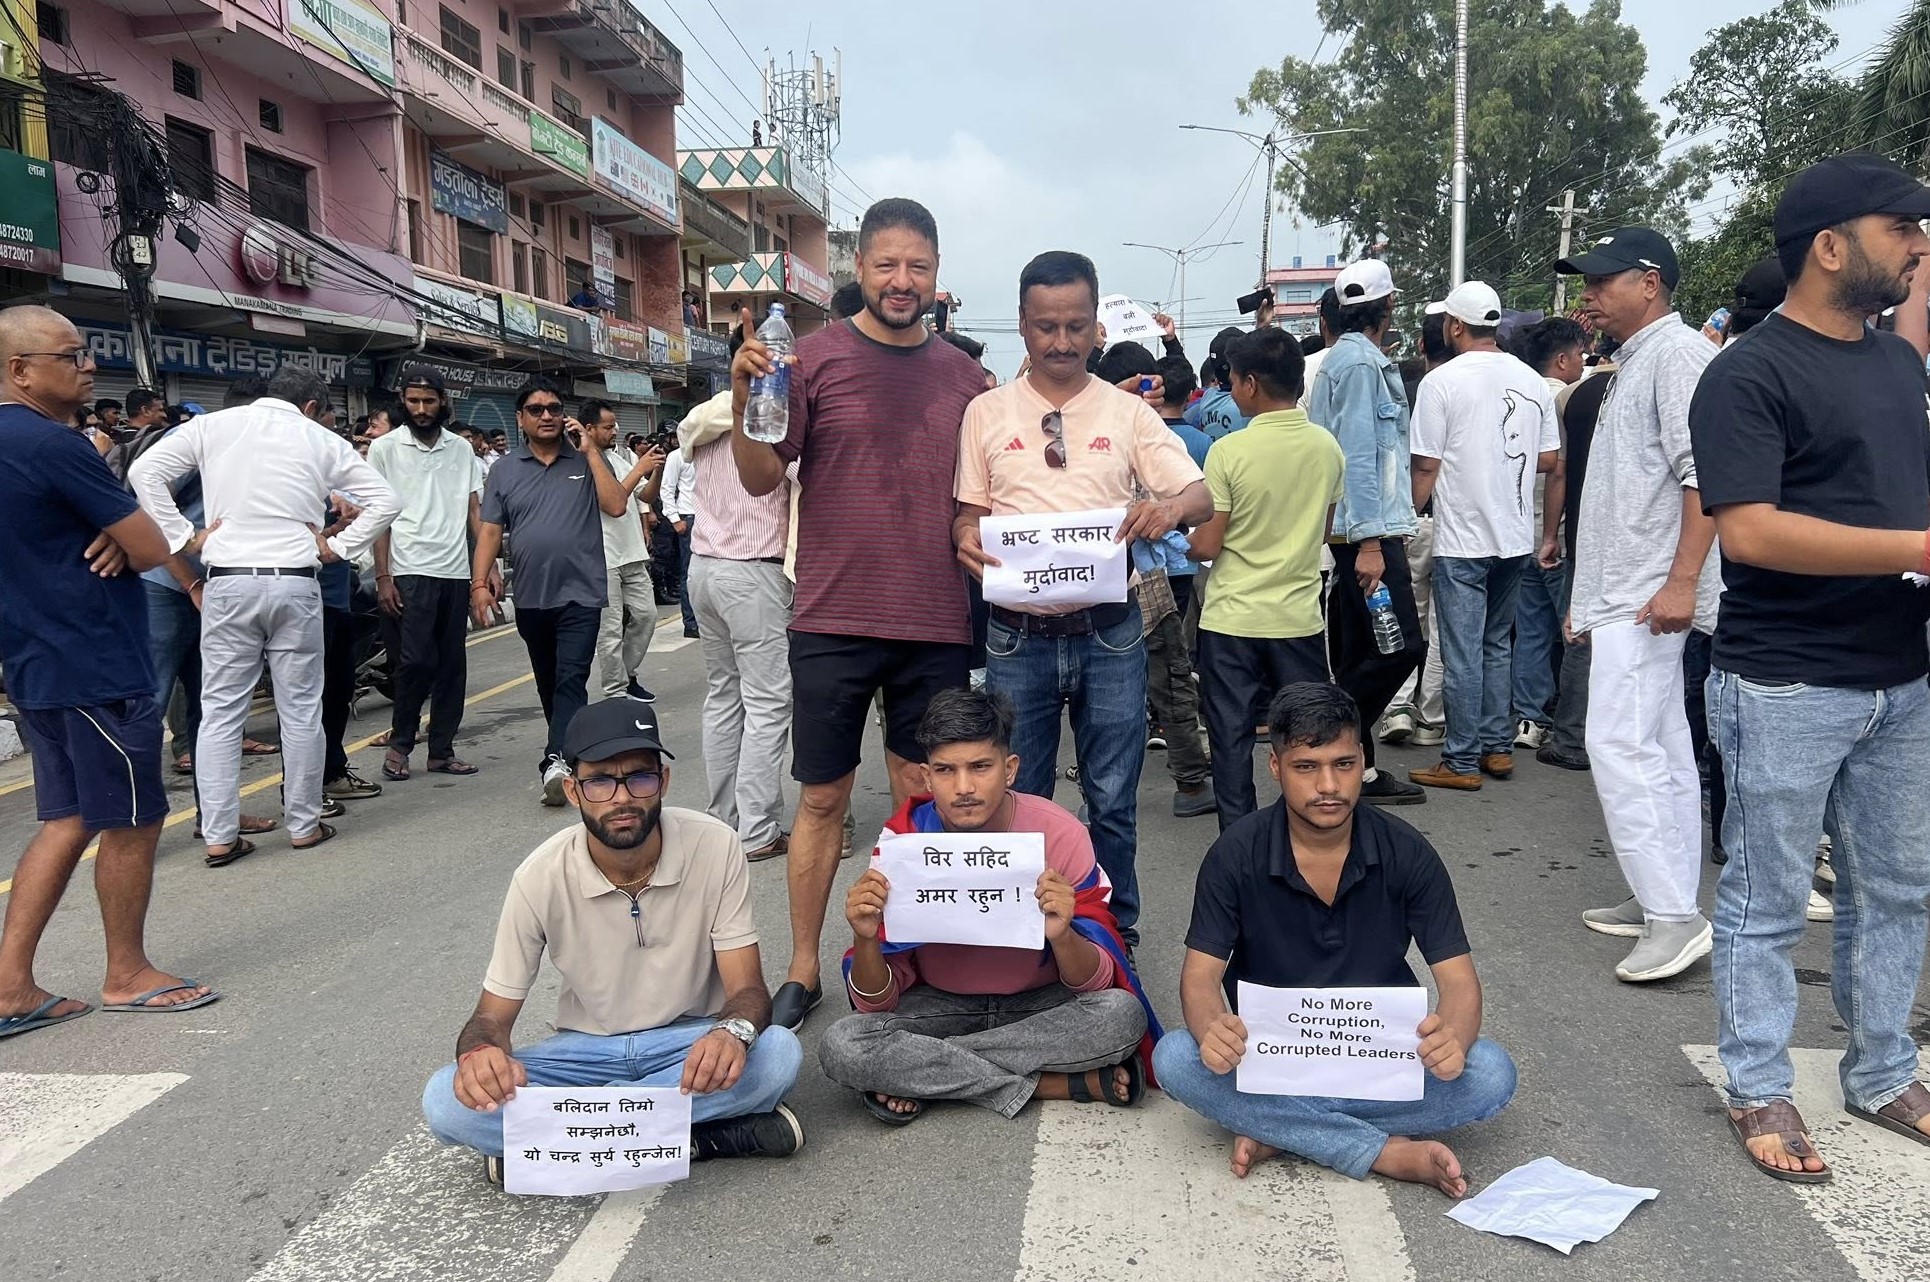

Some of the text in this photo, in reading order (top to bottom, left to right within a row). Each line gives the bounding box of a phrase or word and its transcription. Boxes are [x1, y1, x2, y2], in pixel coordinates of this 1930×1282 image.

[1002, 526, 1113, 547] भ्रष्ट सरकार
[1023, 563, 1095, 593] मुर्दावाद!
[923, 846, 1011, 868] विर सहिद
[915, 888, 958, 904] अमर
[968, 888, 1005, 913] रहुन
[1301, 998, 1373, 1011] No More
[1287, 1012, 1386, 1029] Corruption,
[1300, 1028, 1372, 1043] No More
[1257, 1042, 1416, 1060] Corrupted Leaders
[553, 1098, 655, 1114] बलिदान तिम्रो
[523, 1145, 682, 1168] यो चन्द्र सुर्य रहुन्जेल!
